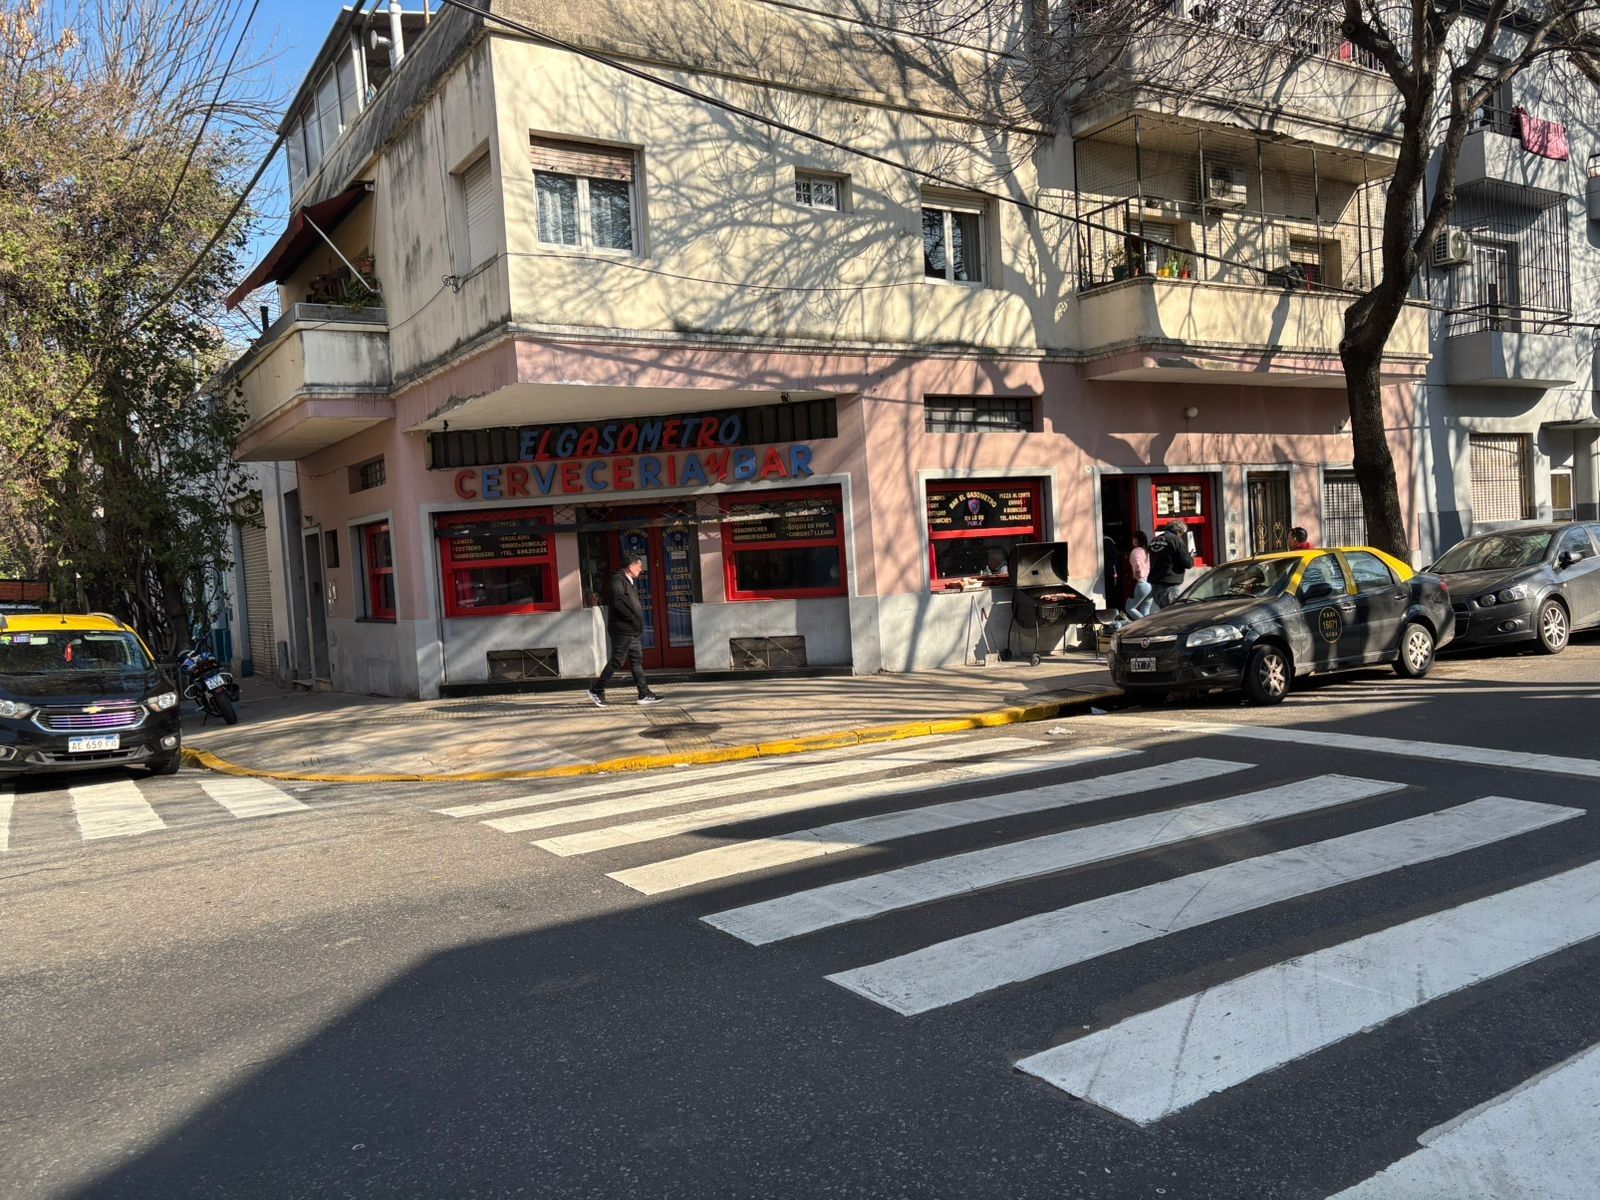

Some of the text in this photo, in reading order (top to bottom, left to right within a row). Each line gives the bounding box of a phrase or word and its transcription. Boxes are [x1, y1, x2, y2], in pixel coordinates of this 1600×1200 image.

[519, 415, 742, 462] EL GASOMETRO
[453, 453, 709, 500] CERVECERIA
[733, 444, 815, 480] BAR
[966, 491, 998, 508] GASOMETRO
[86, 740, 103, 749] 659
